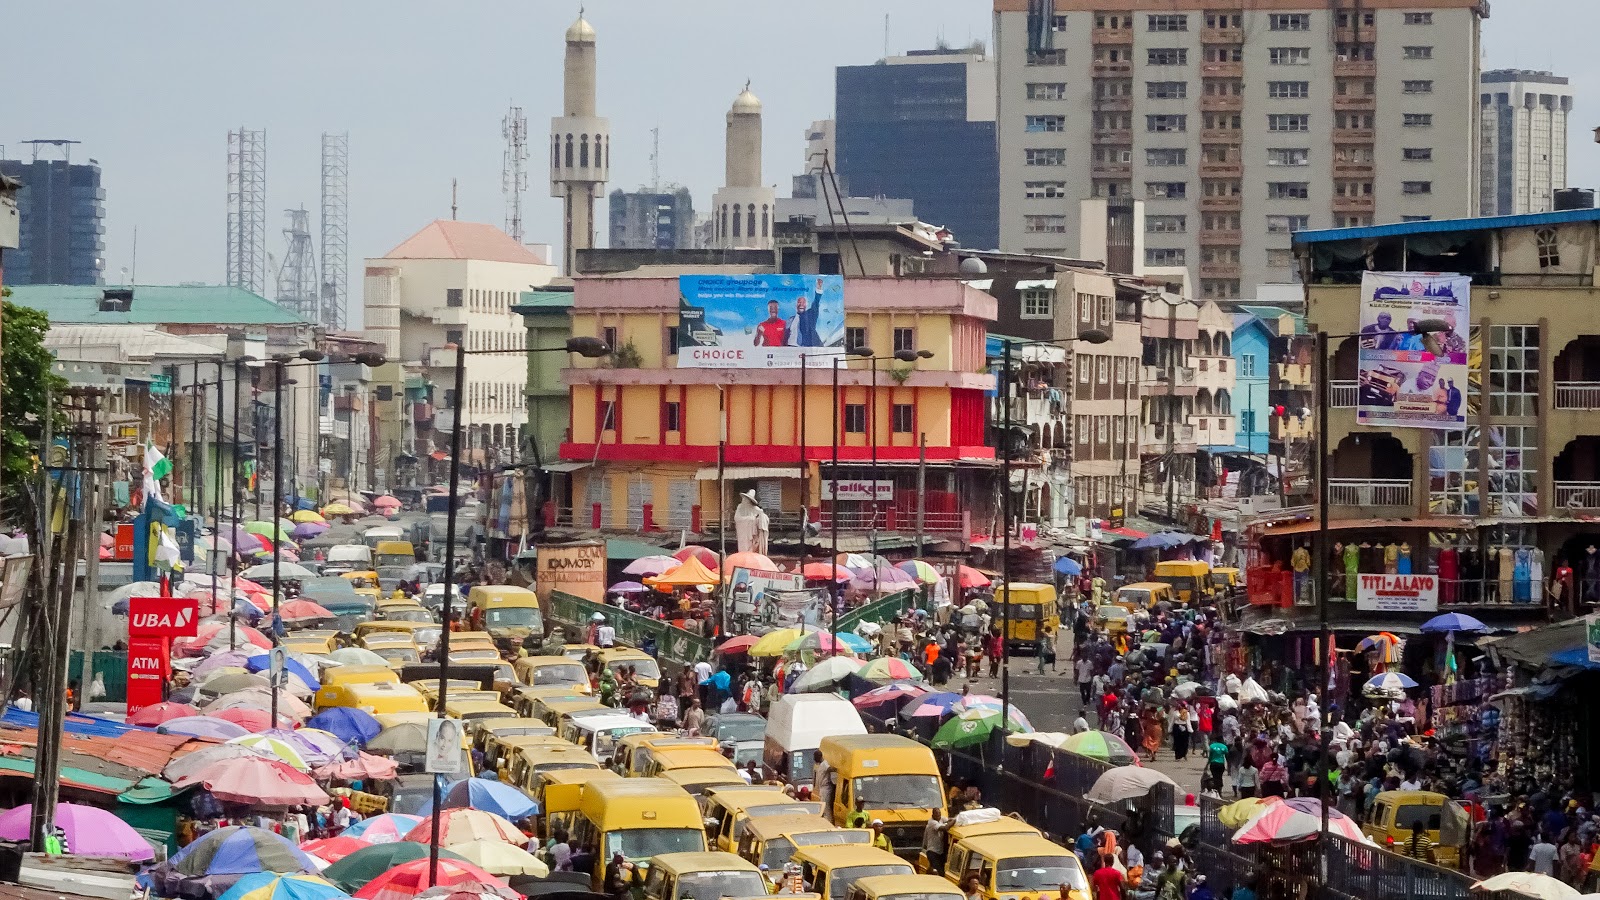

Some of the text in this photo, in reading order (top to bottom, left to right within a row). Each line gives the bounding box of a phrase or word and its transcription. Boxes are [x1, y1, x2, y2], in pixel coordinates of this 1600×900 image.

[1361, 575, 1434, 591] TITI-ALAYO
[132, 613, 171, 628] UBA
[131, 657, 160, 669] ATM
